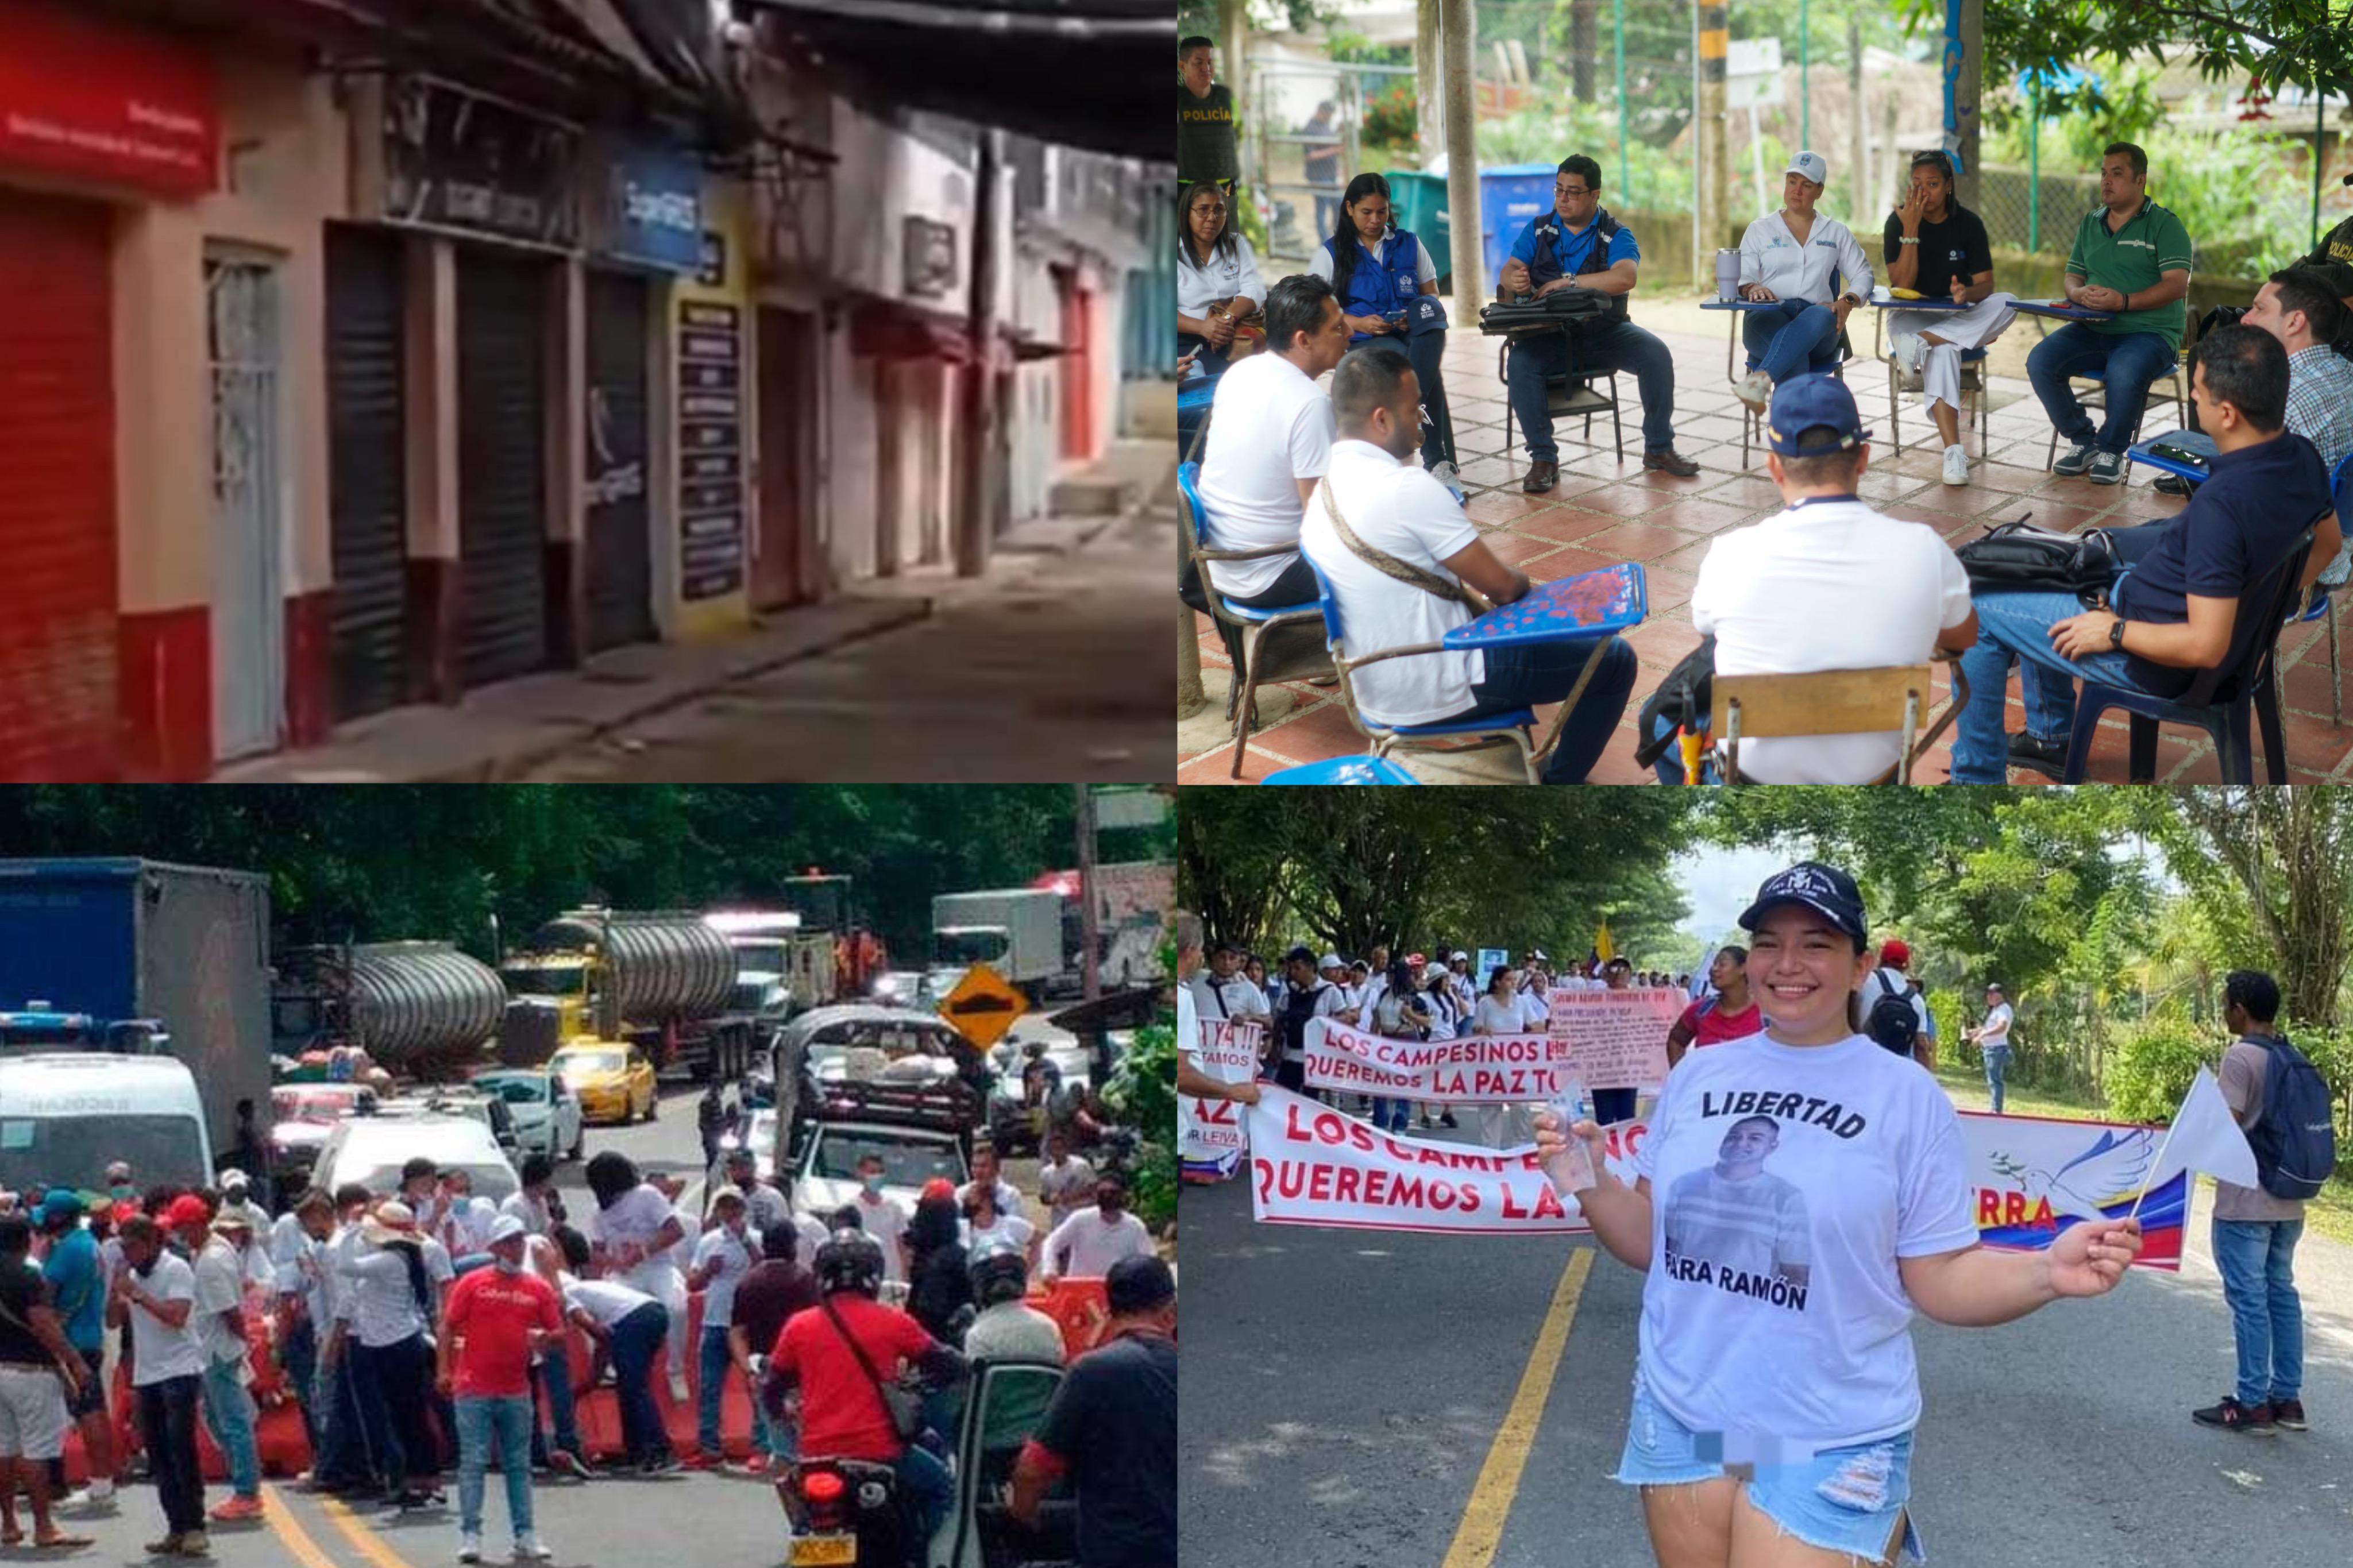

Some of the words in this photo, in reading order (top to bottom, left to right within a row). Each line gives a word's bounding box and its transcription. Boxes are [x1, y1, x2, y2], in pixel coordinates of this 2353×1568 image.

[1183, 107, 1231, 121] POLICÍA
[1324, 1027, 1370, 1057] LOS
[1377, 1041, 1539, 1067] CAMPESINOS
[1432, 1071, 1467, 1094] LA
[1475, 1070, 1525, 1094] PAZ
[1287, 1104, 1374, 1152] LOS
[1702, 1091, 1866, 1140] LIBERTAD
[1500, 1183, 1565, 1219] LA
[1972, 1187, 2057, 1233] RRA
[1719, 1266, 1807, 1312] RAMÓN
